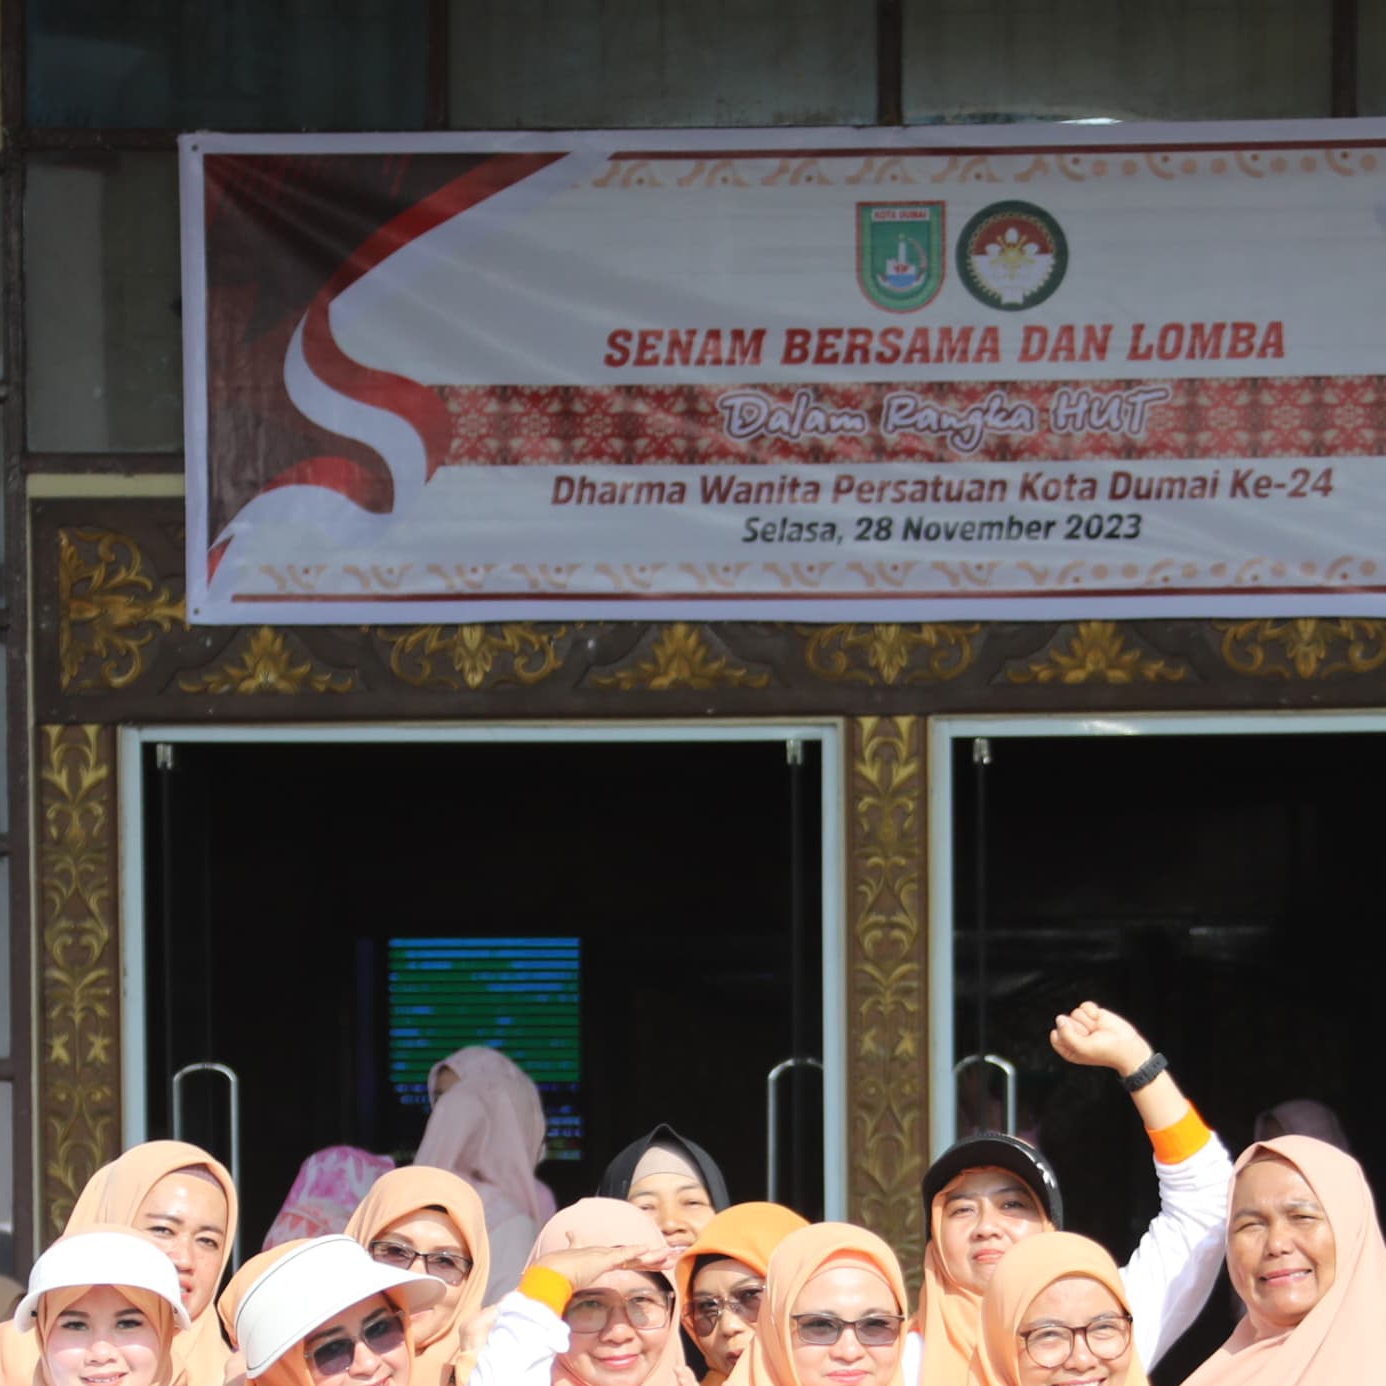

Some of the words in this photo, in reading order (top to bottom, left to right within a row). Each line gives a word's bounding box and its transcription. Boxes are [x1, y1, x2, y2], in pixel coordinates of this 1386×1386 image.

[604, 328, 767, 367] SENAM
[779, 325, 1001, 365] BERSAMA
[1017, 323, 1114, 363] DAN
[1126, 320, 1286, 361] LOMBA
[718, 389, 867, 441] Dalam
[882, 390, 1036, 451] Rangka
[1051, 386, 1170, 437] HUT
[550, 475, 686, 506] Dharma
[700, 474, 822, 505] Wanita
[831, 473, 1007, 504] Persatuan
[1019, 471, 1098, 502] Kota
[1108, 469, 1220, 501] Dumai
[1228, 467, 1335, 499] Ke-24
[741, 515, 843, 546] Selasa,
[853, 515, 893, 542] 28
[902, 513, 1056, 542] November
[1063, 512, 1143, 541] 2023
